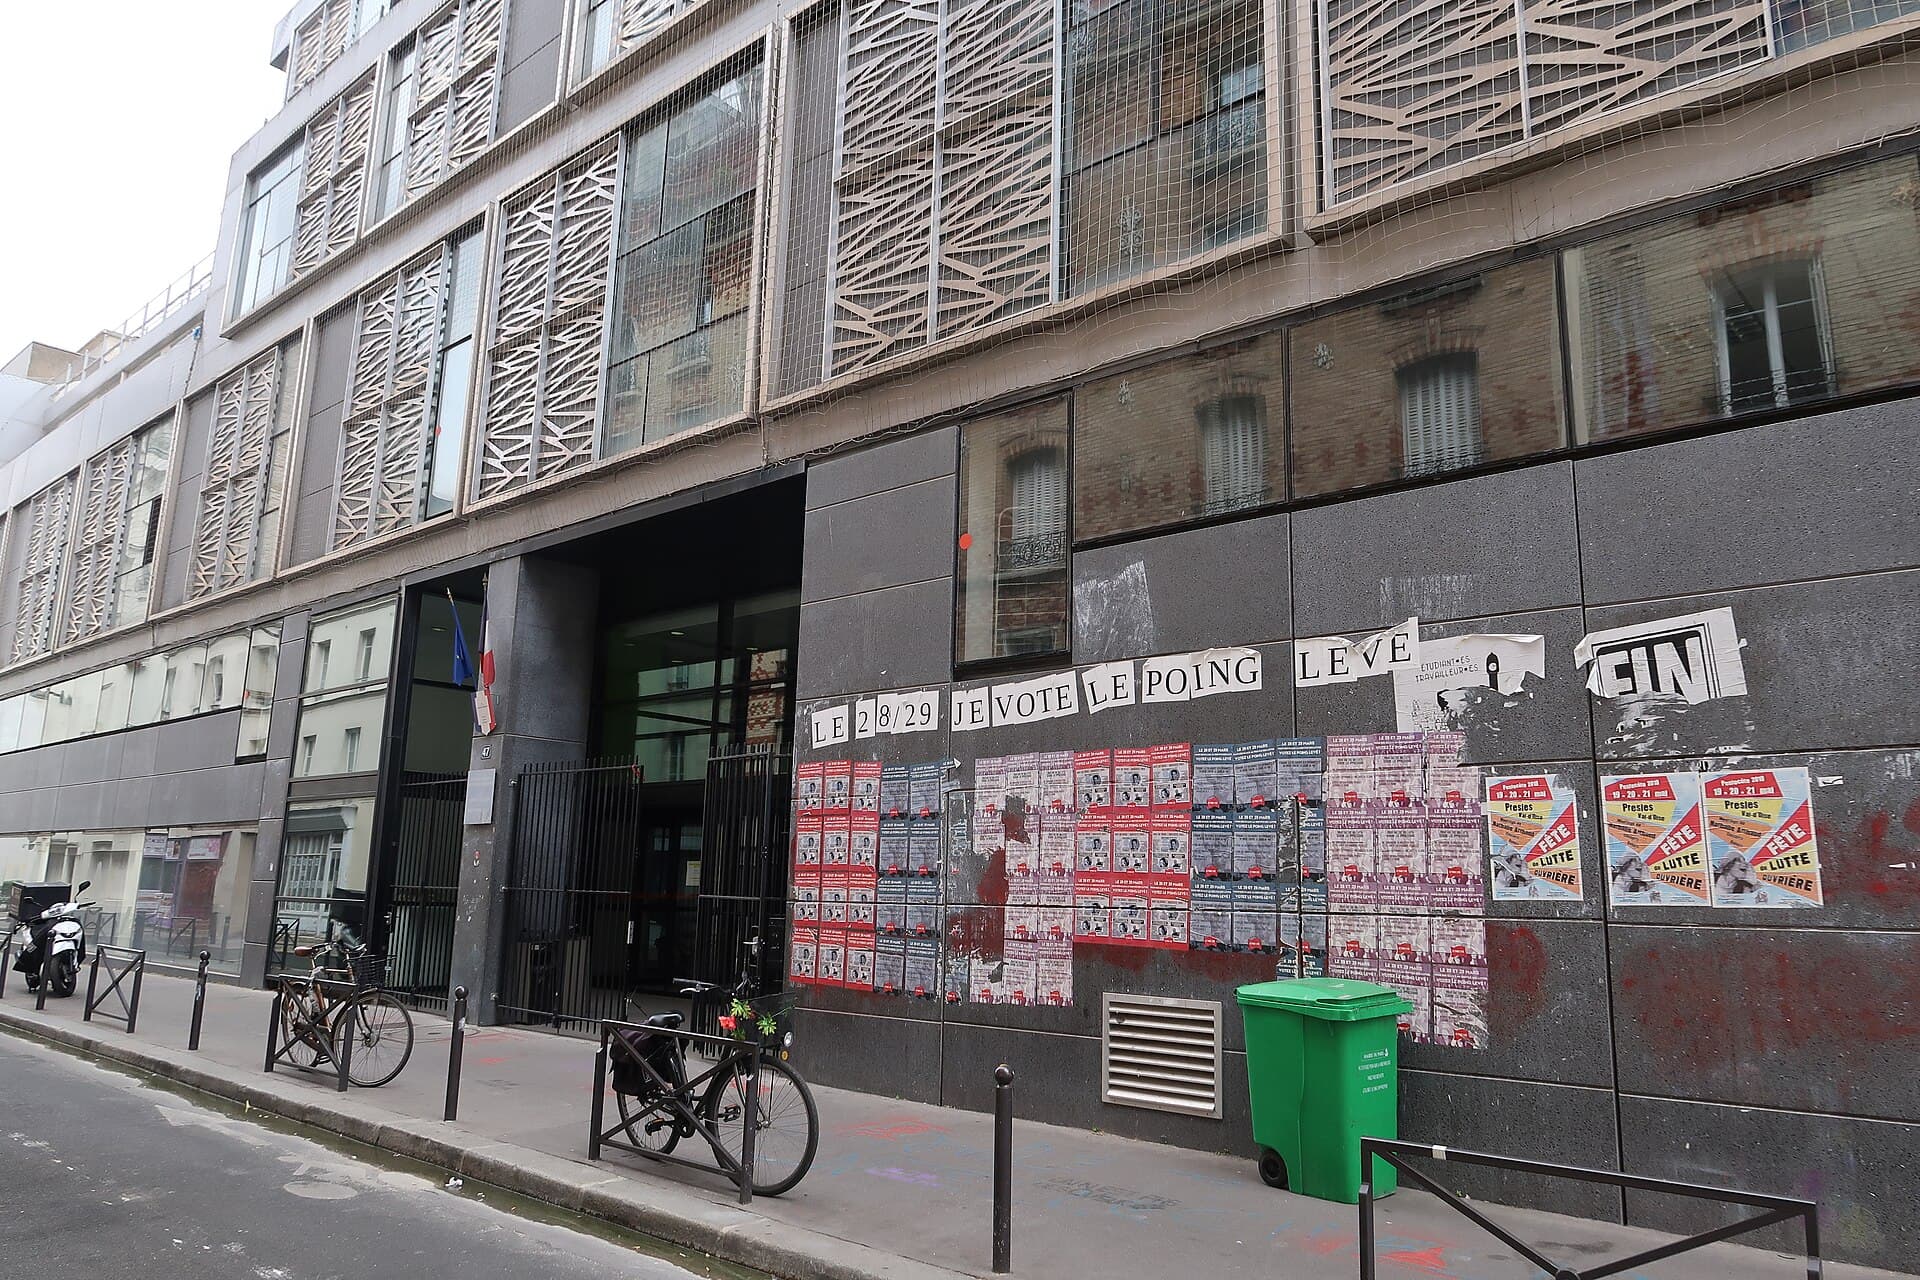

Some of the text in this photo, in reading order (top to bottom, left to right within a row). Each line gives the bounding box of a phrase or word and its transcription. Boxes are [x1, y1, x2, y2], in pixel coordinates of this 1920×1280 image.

[814, 716, 845, 743] LE
[858, 702, 931, 733] 28/29
[954, 699, 984, 726] JE
[995, 684, 1073, 720] VOTE
[1087, 673, 1129, 707] LE
[1146, 656, 1259, 697] POING
[1746, 786, 1756, 794] 21
[1505, 803, 1533, 812] Presles
[1622, 803, 1654, 812] Presles
[1724, 800, 1758, 810] Presles
[1538, 824, 1572, 853] FÊTE
[1660, 824, 1696, 856] FÊTE
[1766, 823, 1807, 856] FÊTE
[1540, 850, 1574, 867] LUTTE
[1662, 852, 1700, 871] LUTTE
[1769, 852, 1811, 871] LUTTE
[1534, 870, 1576, 886] OUVRIÈRE
[1656, 873, 1702, 890] OUVRIÈRE
[1762, 874, 1814, 892] OUVRIÈRE
